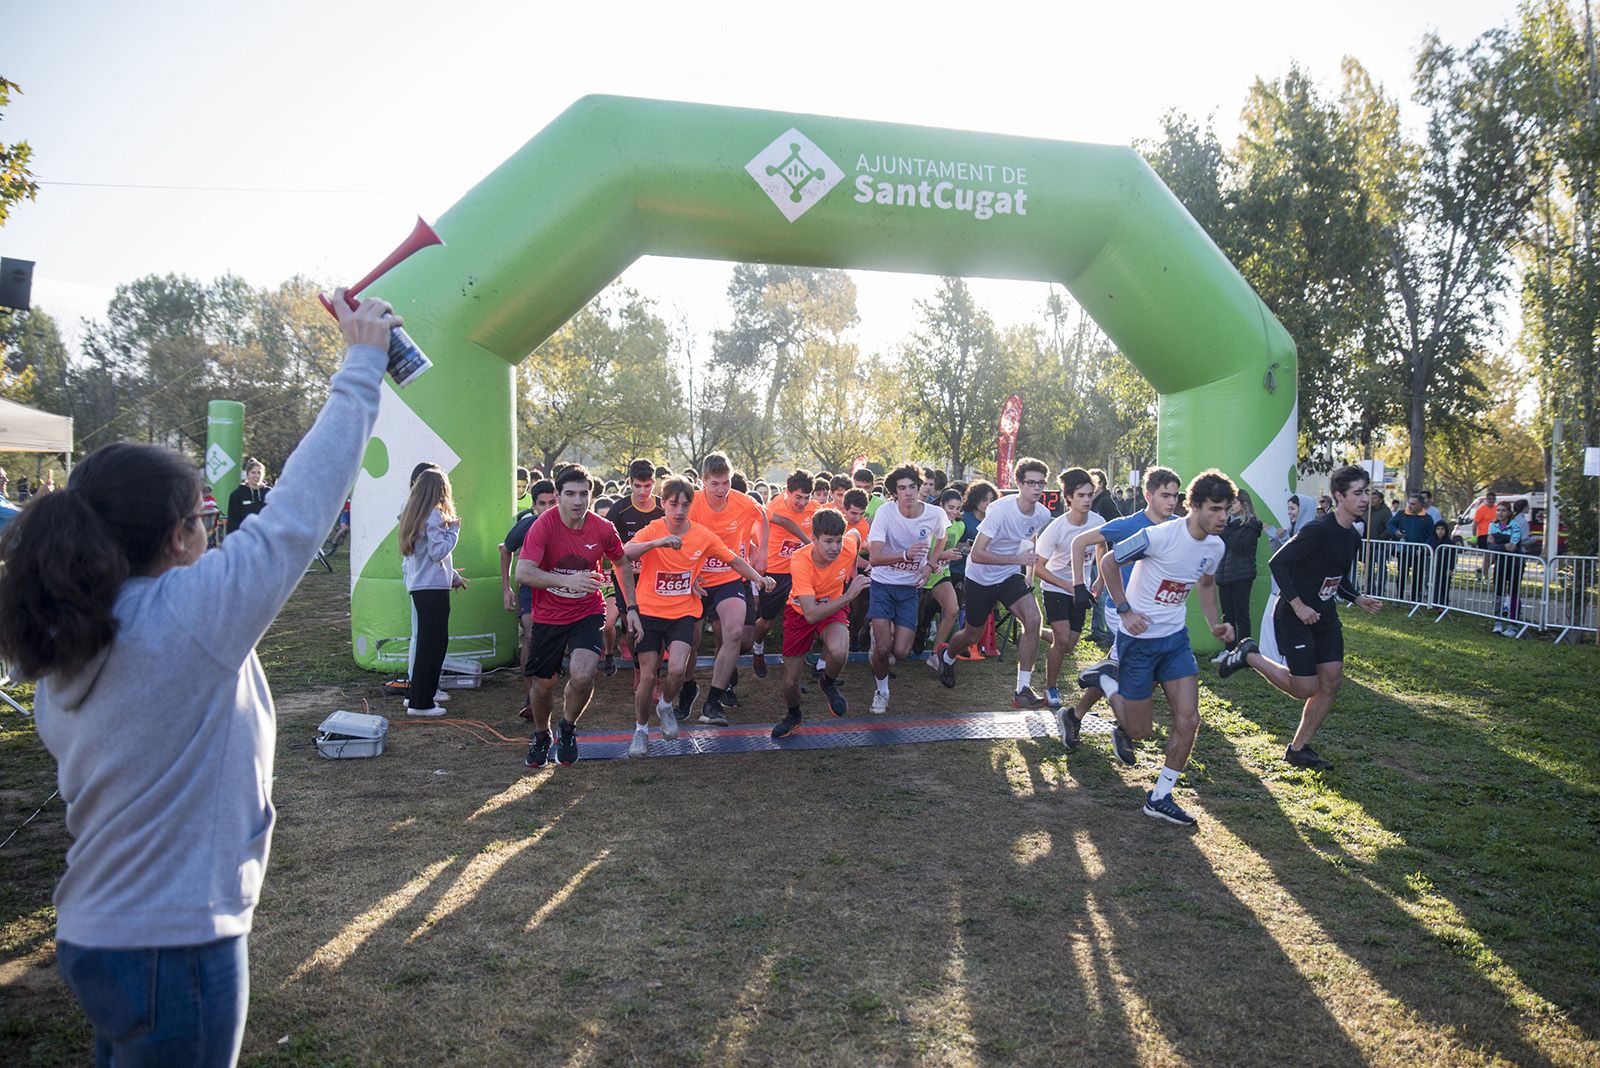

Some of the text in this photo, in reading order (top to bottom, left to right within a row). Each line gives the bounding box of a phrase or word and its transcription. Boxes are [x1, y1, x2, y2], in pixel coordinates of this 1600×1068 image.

[855, 153, 1029, 185] AJUNTAMENT DE
[853, 175, 1029, 220] SantCugat
[704, 556, 728, 567] 265
[658, 579, 689, 591] 2664
[1157, 589, 1187, 603] 4091
